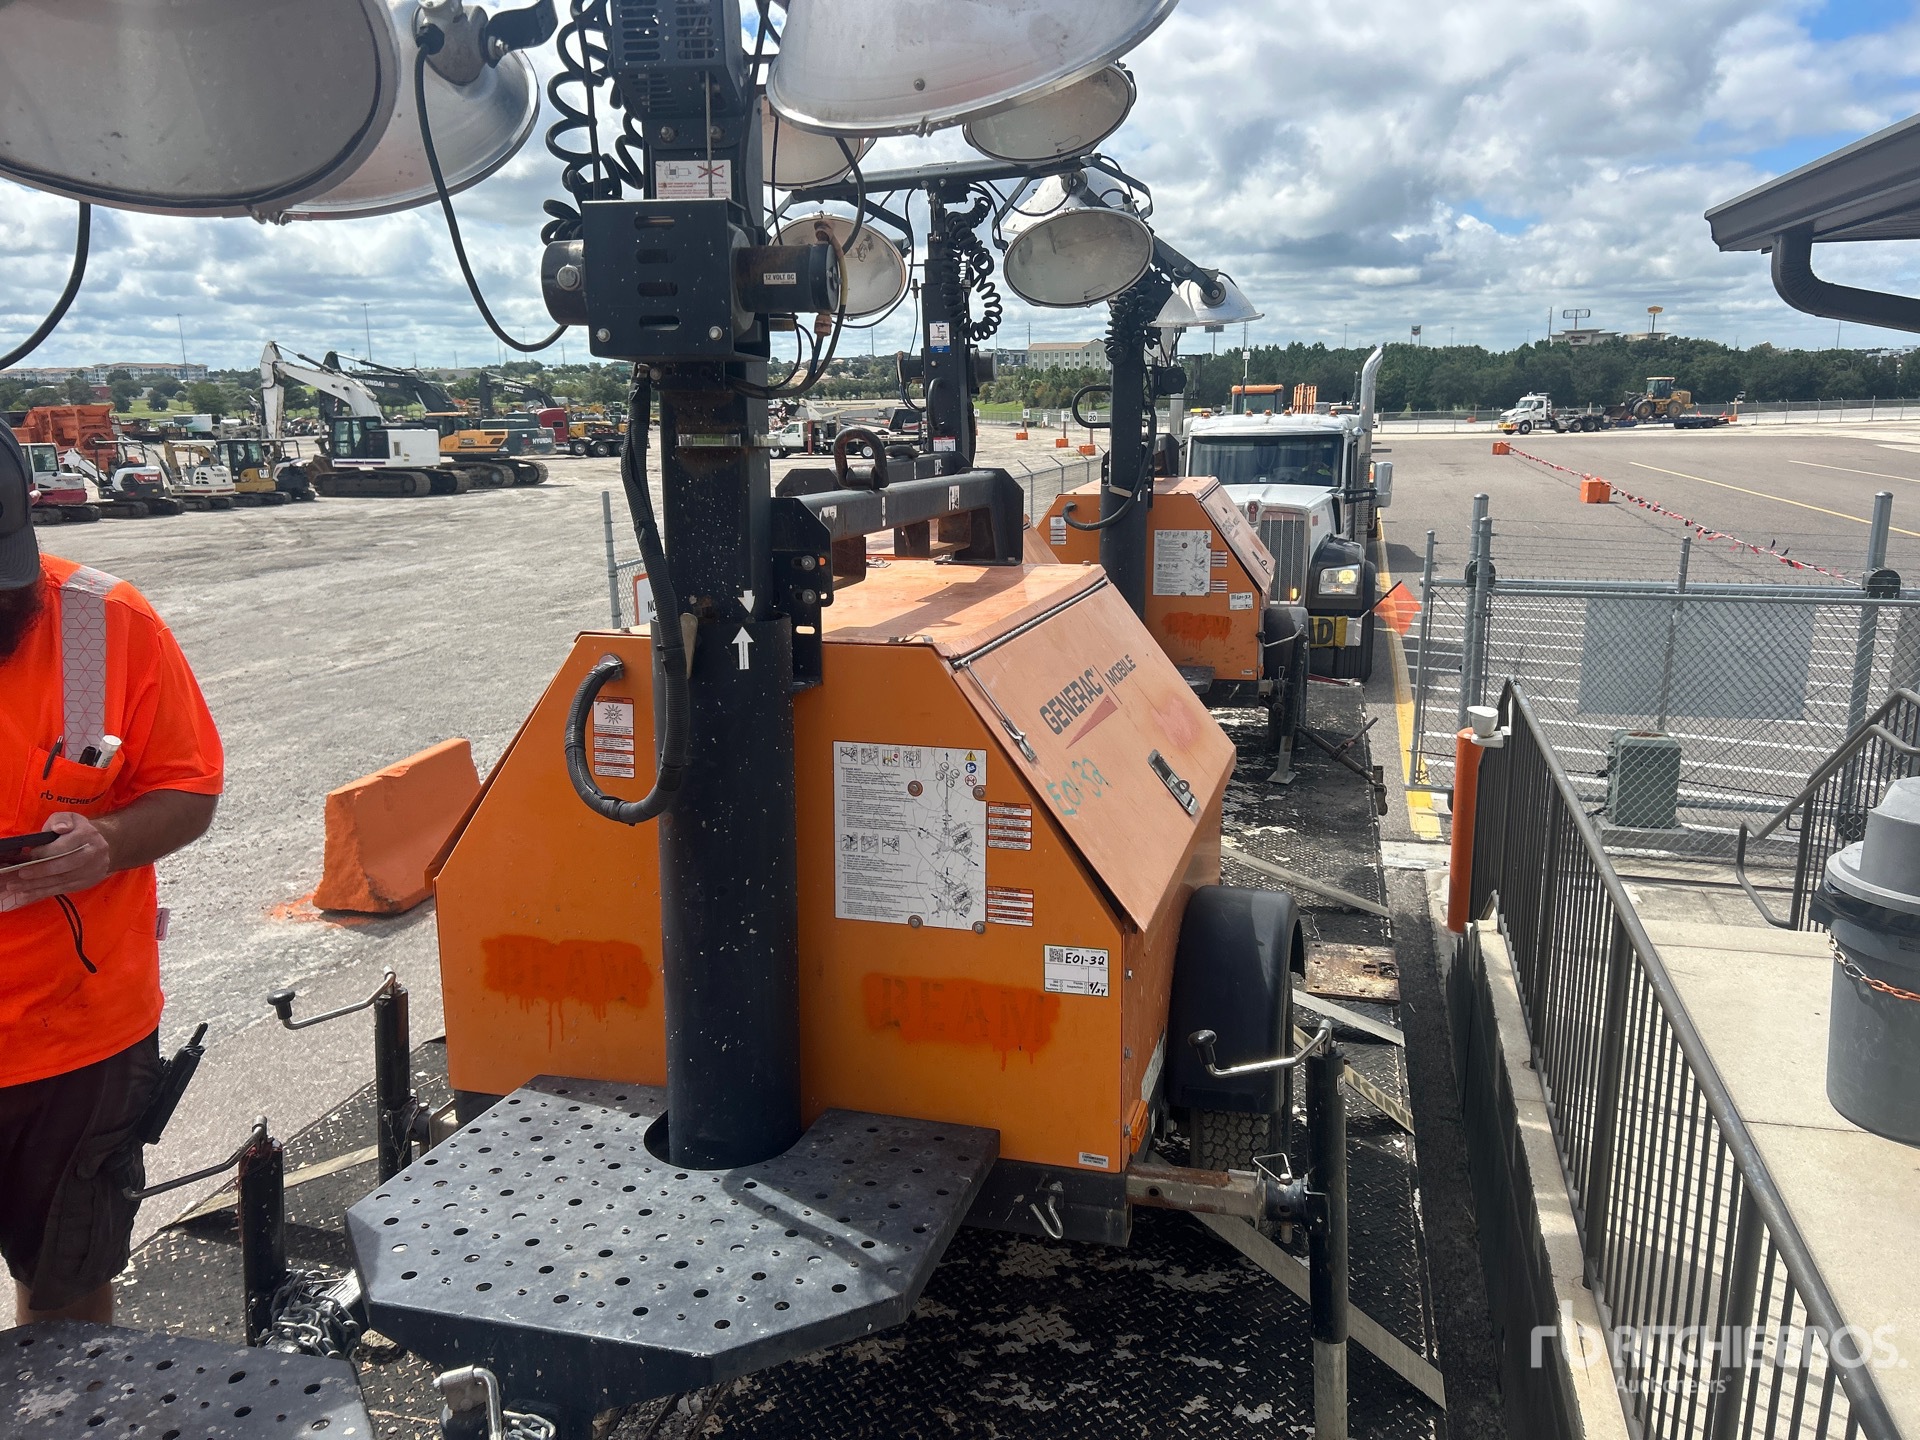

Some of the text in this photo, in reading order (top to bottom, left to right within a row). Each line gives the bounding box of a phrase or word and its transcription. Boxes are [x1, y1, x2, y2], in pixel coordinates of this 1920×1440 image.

[786, 273, 795, 281] DC
[503, 385, 525, 395] DEERE
[532, 437, 553, 445] HYUNDAI
[1039, 654, 1136, 736] GENERAC MOBILE
[40, 790, 54, 801] rb
[57, 795, 90, 805] RITCHIE
[1065, 952, 1105, 966] E01-32
